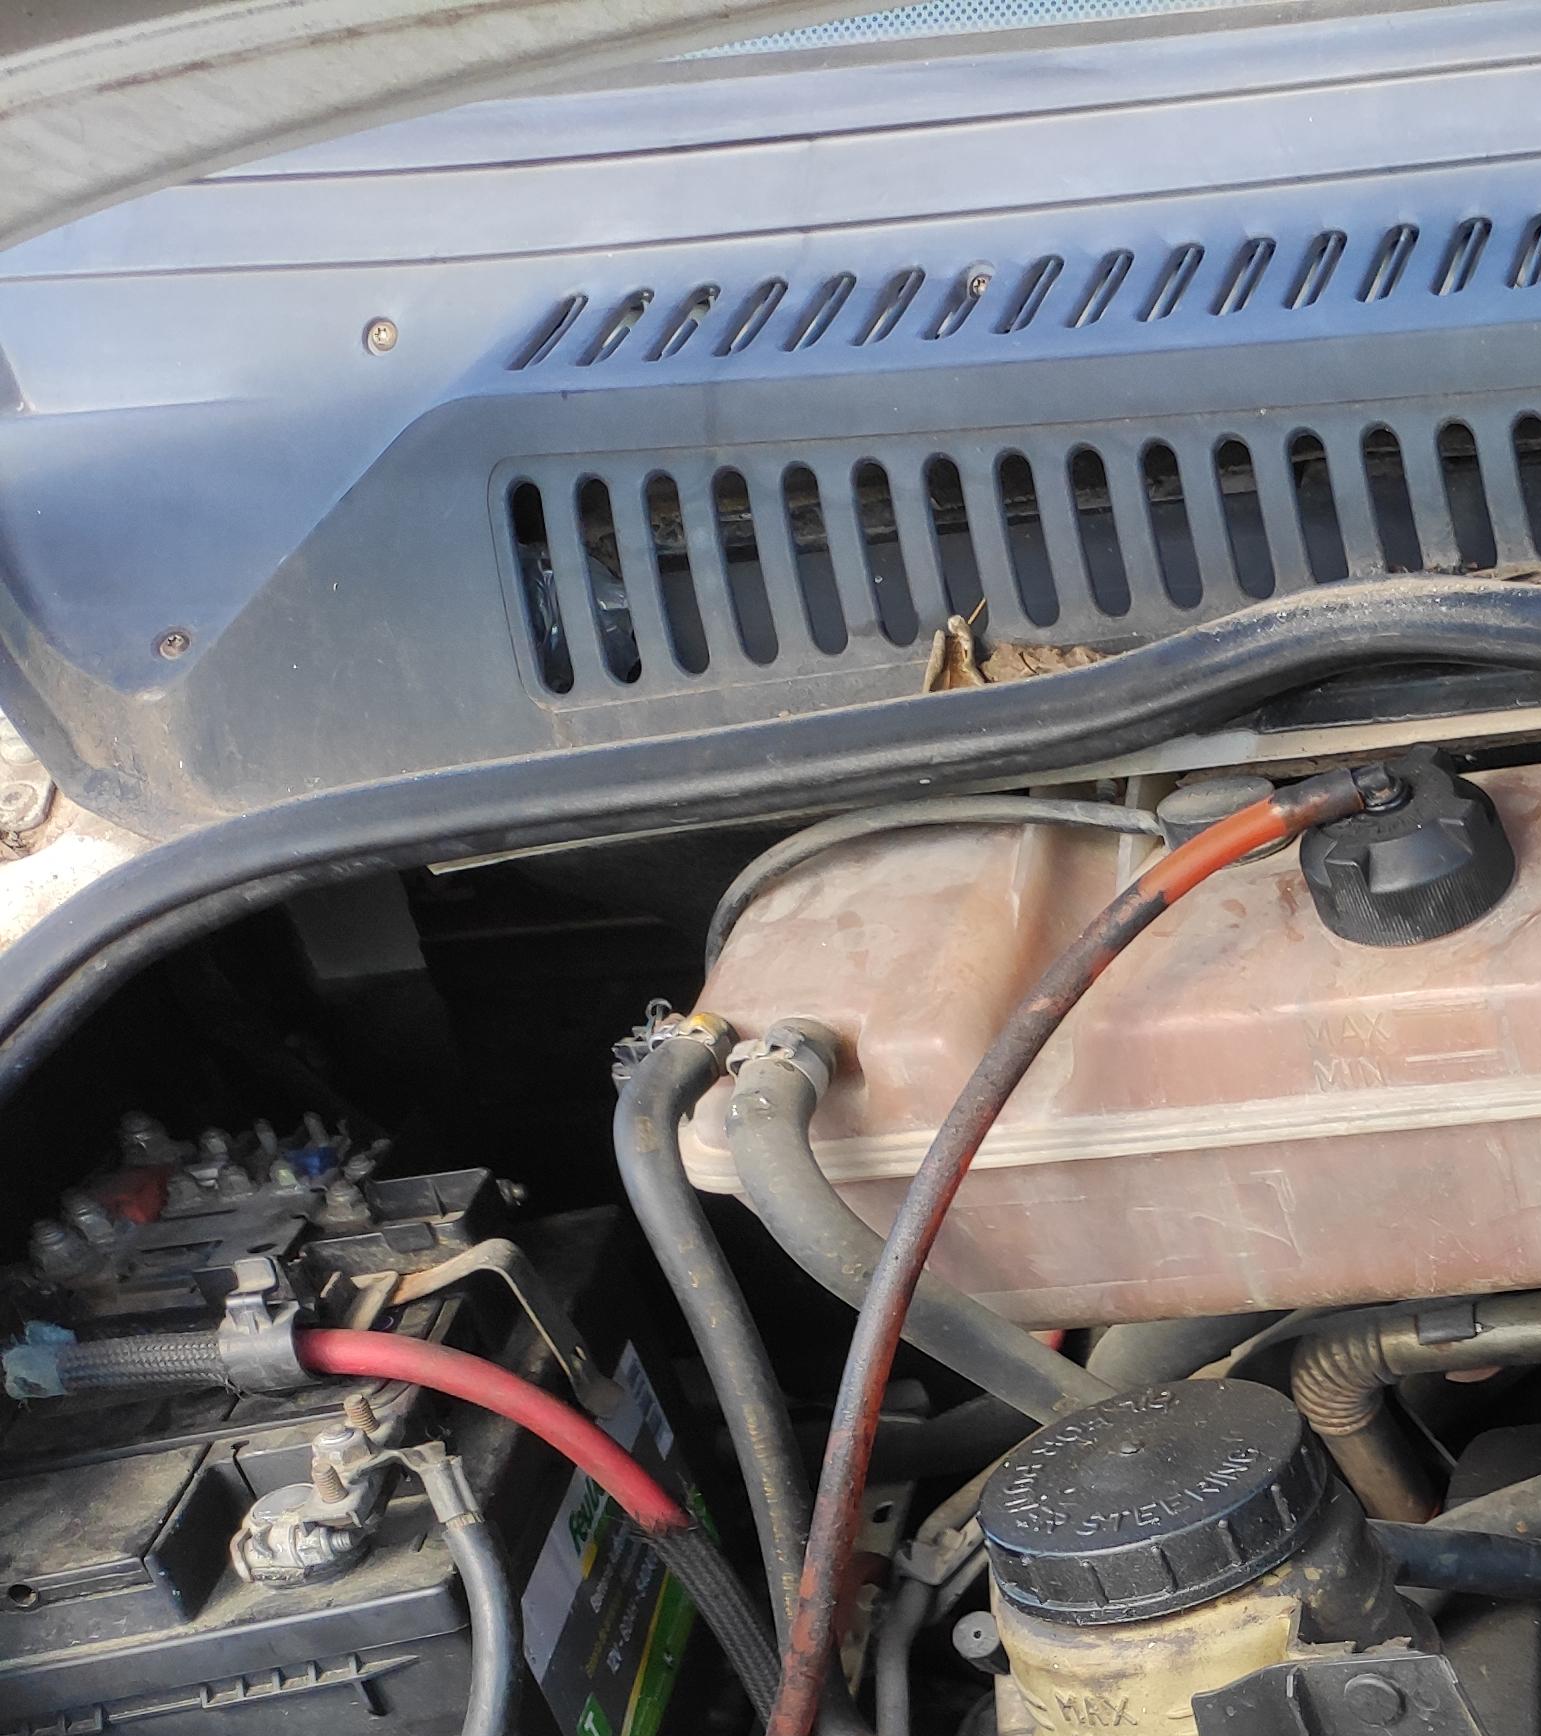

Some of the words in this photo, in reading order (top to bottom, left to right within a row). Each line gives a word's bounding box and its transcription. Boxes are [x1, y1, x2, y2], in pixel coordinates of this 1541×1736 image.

[1302, 1011, 1392, 1049] MAX
[1312, 1056, 1388, 1092] MIN
[1076, 1448, 1259, 1537] STEERING
[1054, 1689, 1139, 1728] MAX
